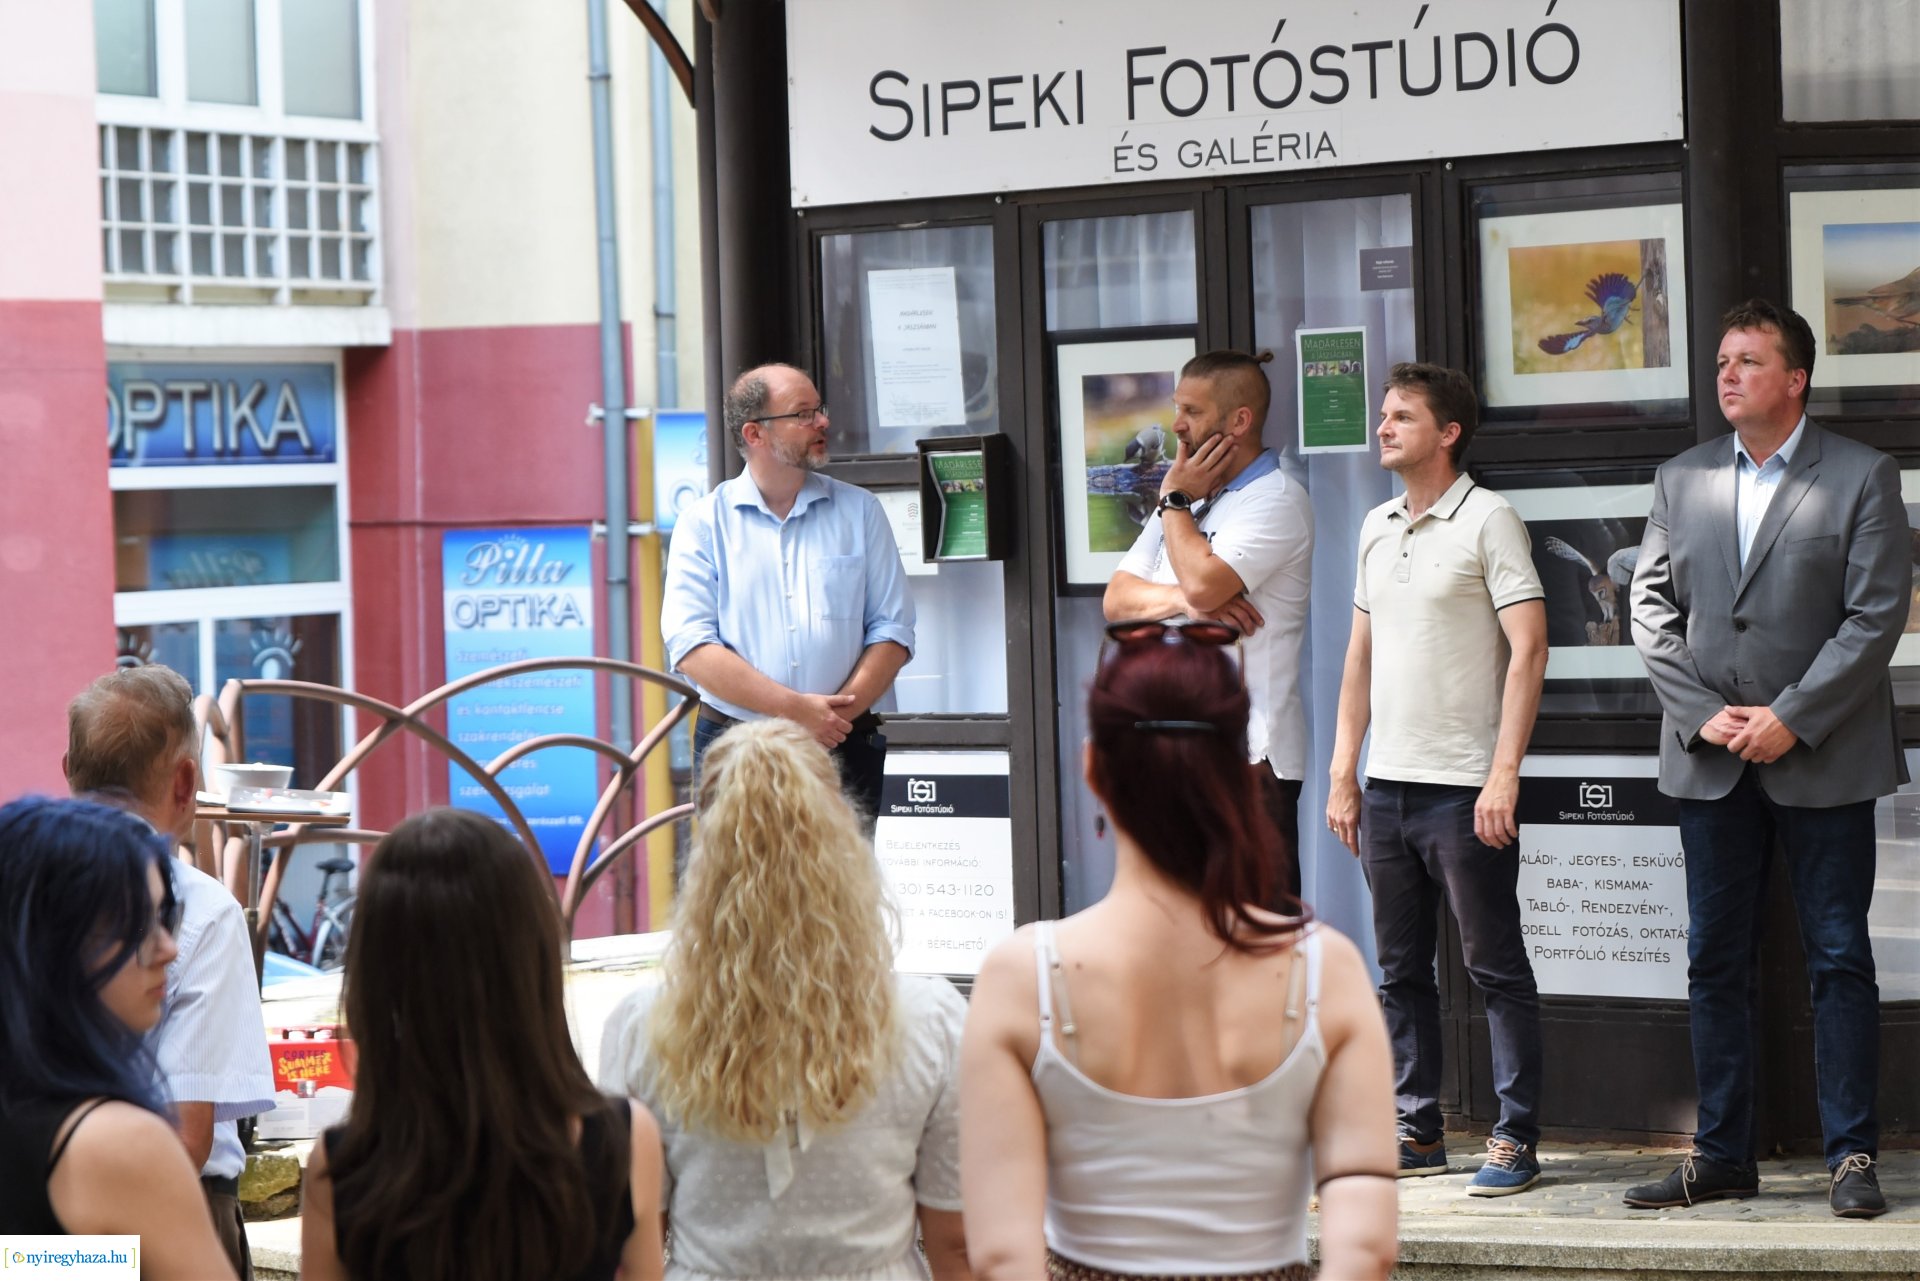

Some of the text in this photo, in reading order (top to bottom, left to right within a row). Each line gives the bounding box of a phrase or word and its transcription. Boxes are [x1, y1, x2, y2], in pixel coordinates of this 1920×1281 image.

[1113, 121, 1338, 173] ÉS GALÉRIA
[460, 542, 574, 586] Pilla
[453, 595, 583, 629] OPTIKA
[1520, 849, 1562, 867] ALÁDI-,
[926, 883, 995, 897] 543-1120
[1547, 878, 1653, 891] BABA-, KISMAMA-
[929, 909, 992, 919] FACEBOOK-ON
[1521, 924, 1562, 937] ODELL
[1572, 921, 1633, 940] FOTÓZÁS,
[1612, 946, 1671, 963] KÉSZÍTÉS
